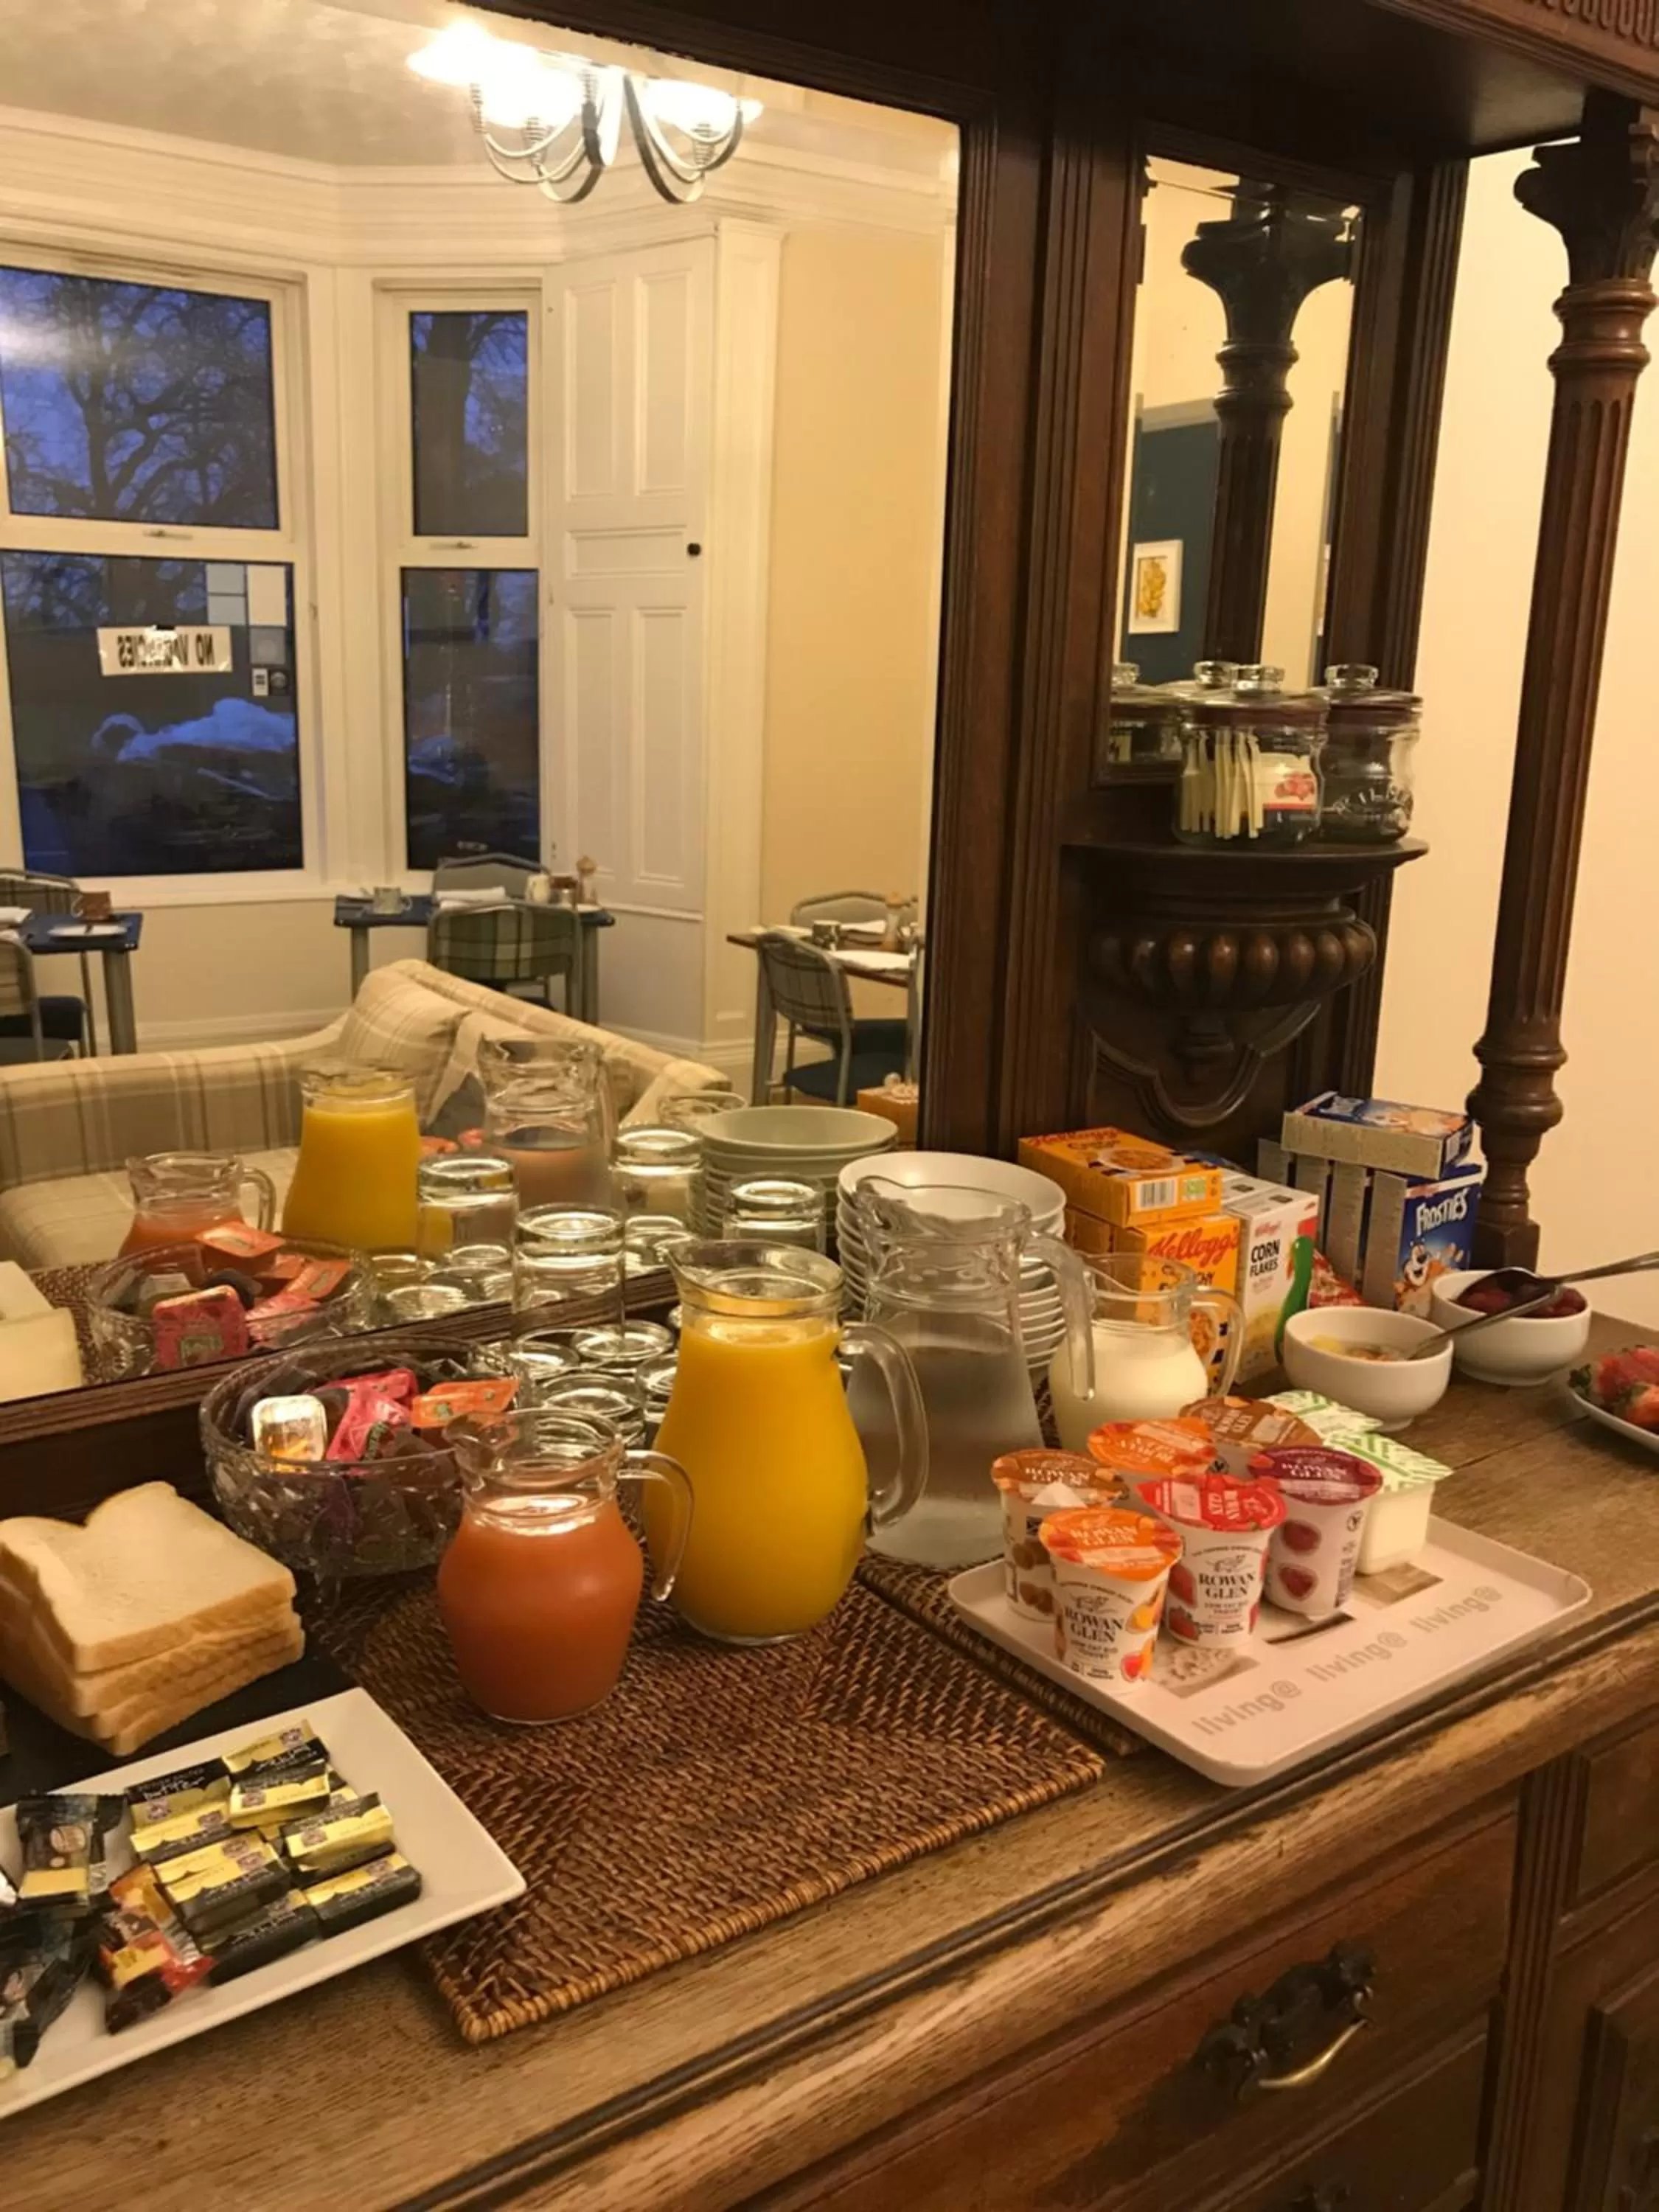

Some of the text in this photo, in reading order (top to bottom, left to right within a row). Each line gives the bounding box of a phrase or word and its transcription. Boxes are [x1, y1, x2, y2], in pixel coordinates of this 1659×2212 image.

[1251, 1239, 1281, 1263] CORN
[1249, 1258, 1279, 1278] FLAKES
[1199, 1571, 1256, 1585] ROWAN
[1206, 1587, 1248, 1599] GLEN
[1065, 1606, 1124, 1631] ROWAN
[1410, 1585, 1503, 1634] living@
[1070, 1622, 1116, 1643] GLEN
[1304, 1630, 1408, 1683] living@
[1191, 1679, 1302, 1736] living@
